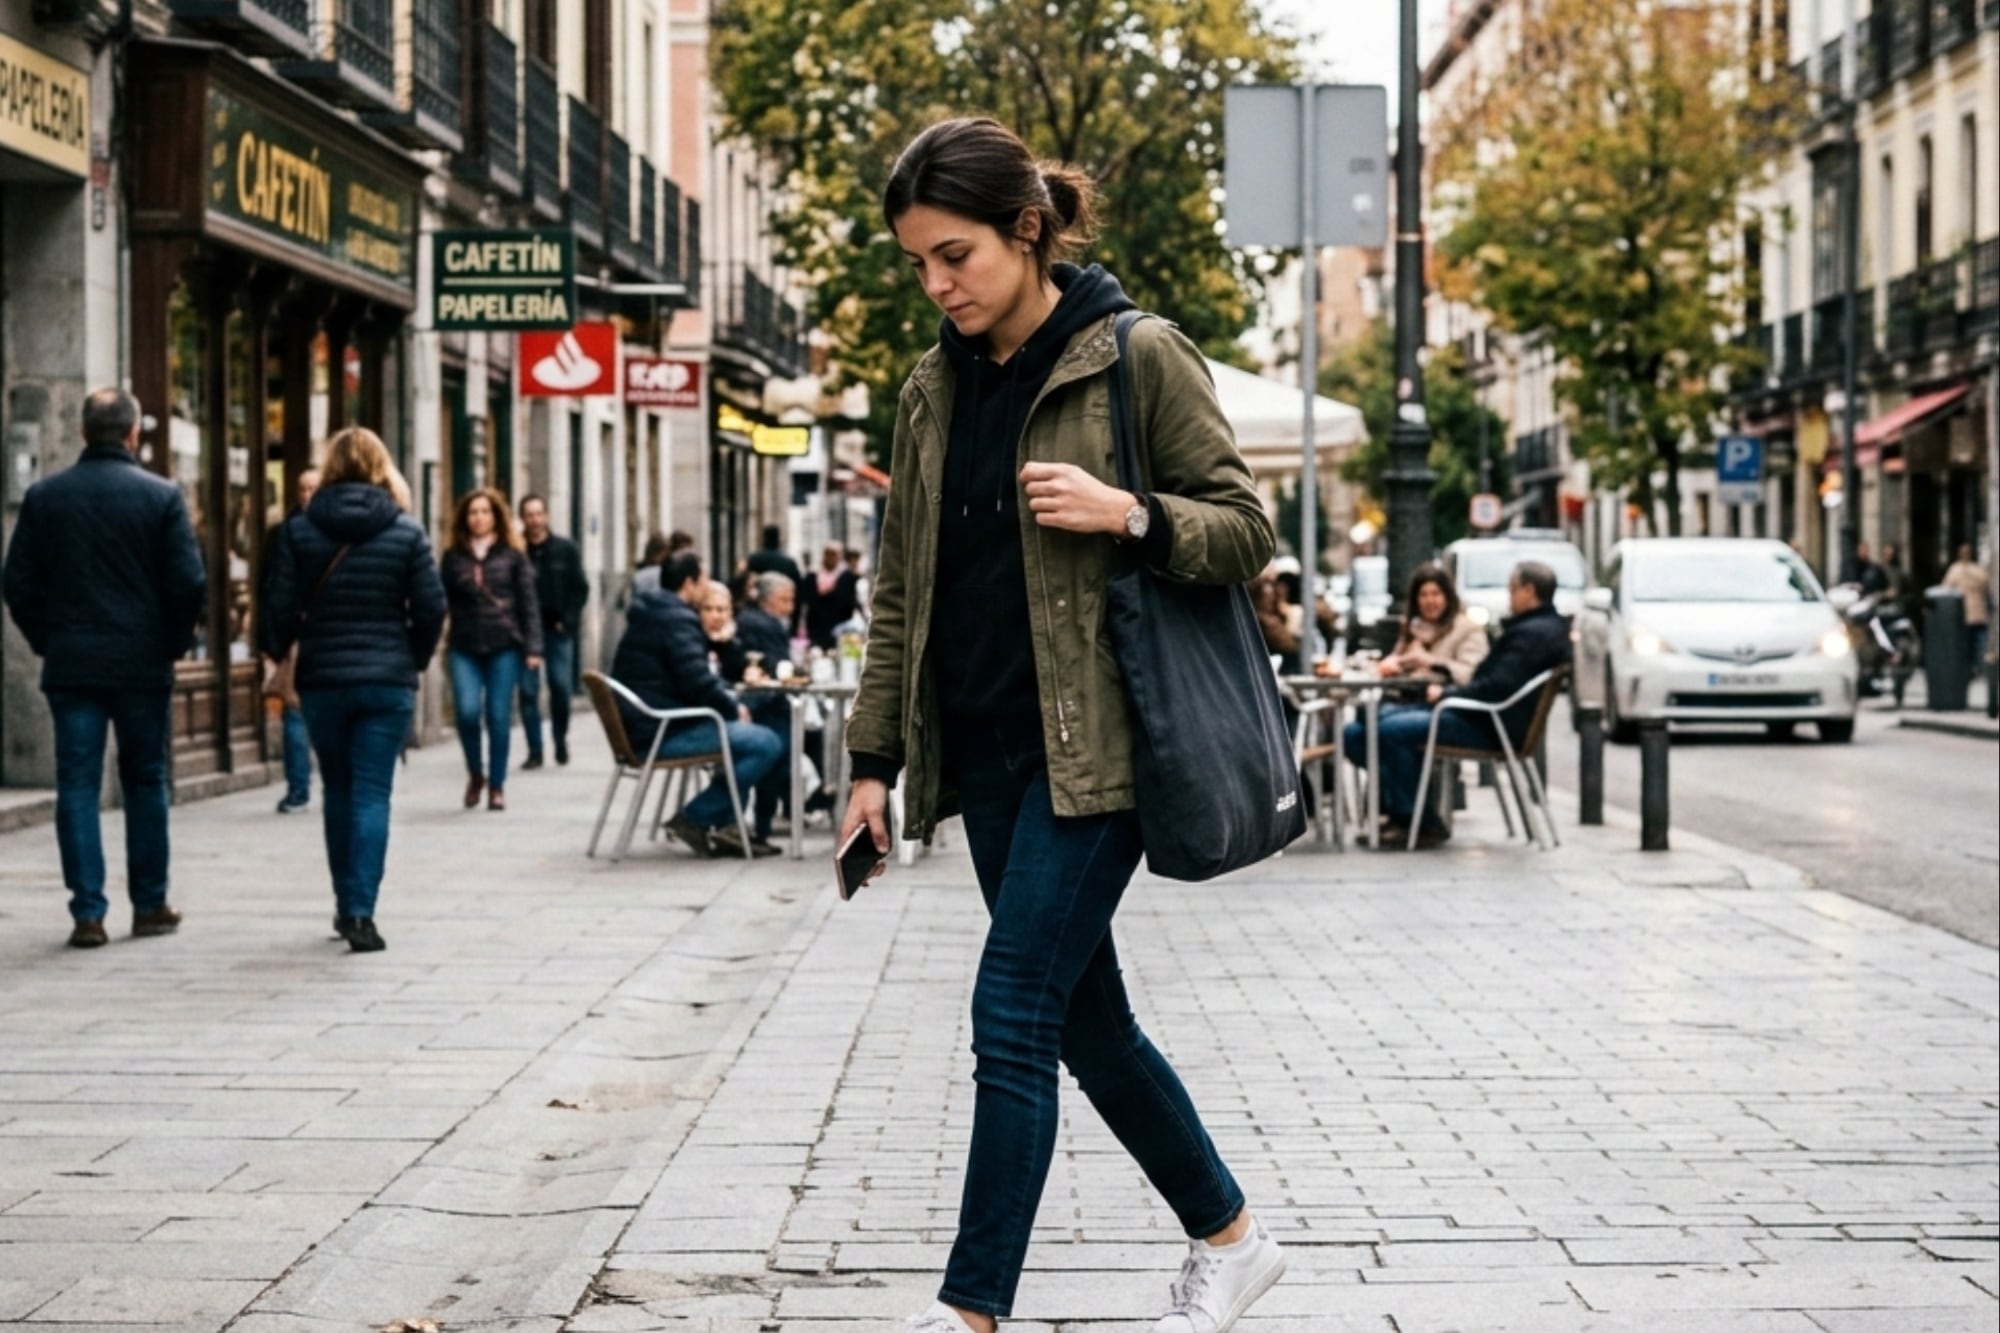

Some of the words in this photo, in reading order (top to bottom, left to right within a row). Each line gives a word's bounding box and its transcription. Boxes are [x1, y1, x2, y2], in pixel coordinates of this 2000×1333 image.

[237, 131, 331, 248] CAFETÍN
[444, 234, 561, 272] CAFETÍN
[438, 288, 568, 320] PAPELERÍA
[1725, 440, 1752, 471] P
